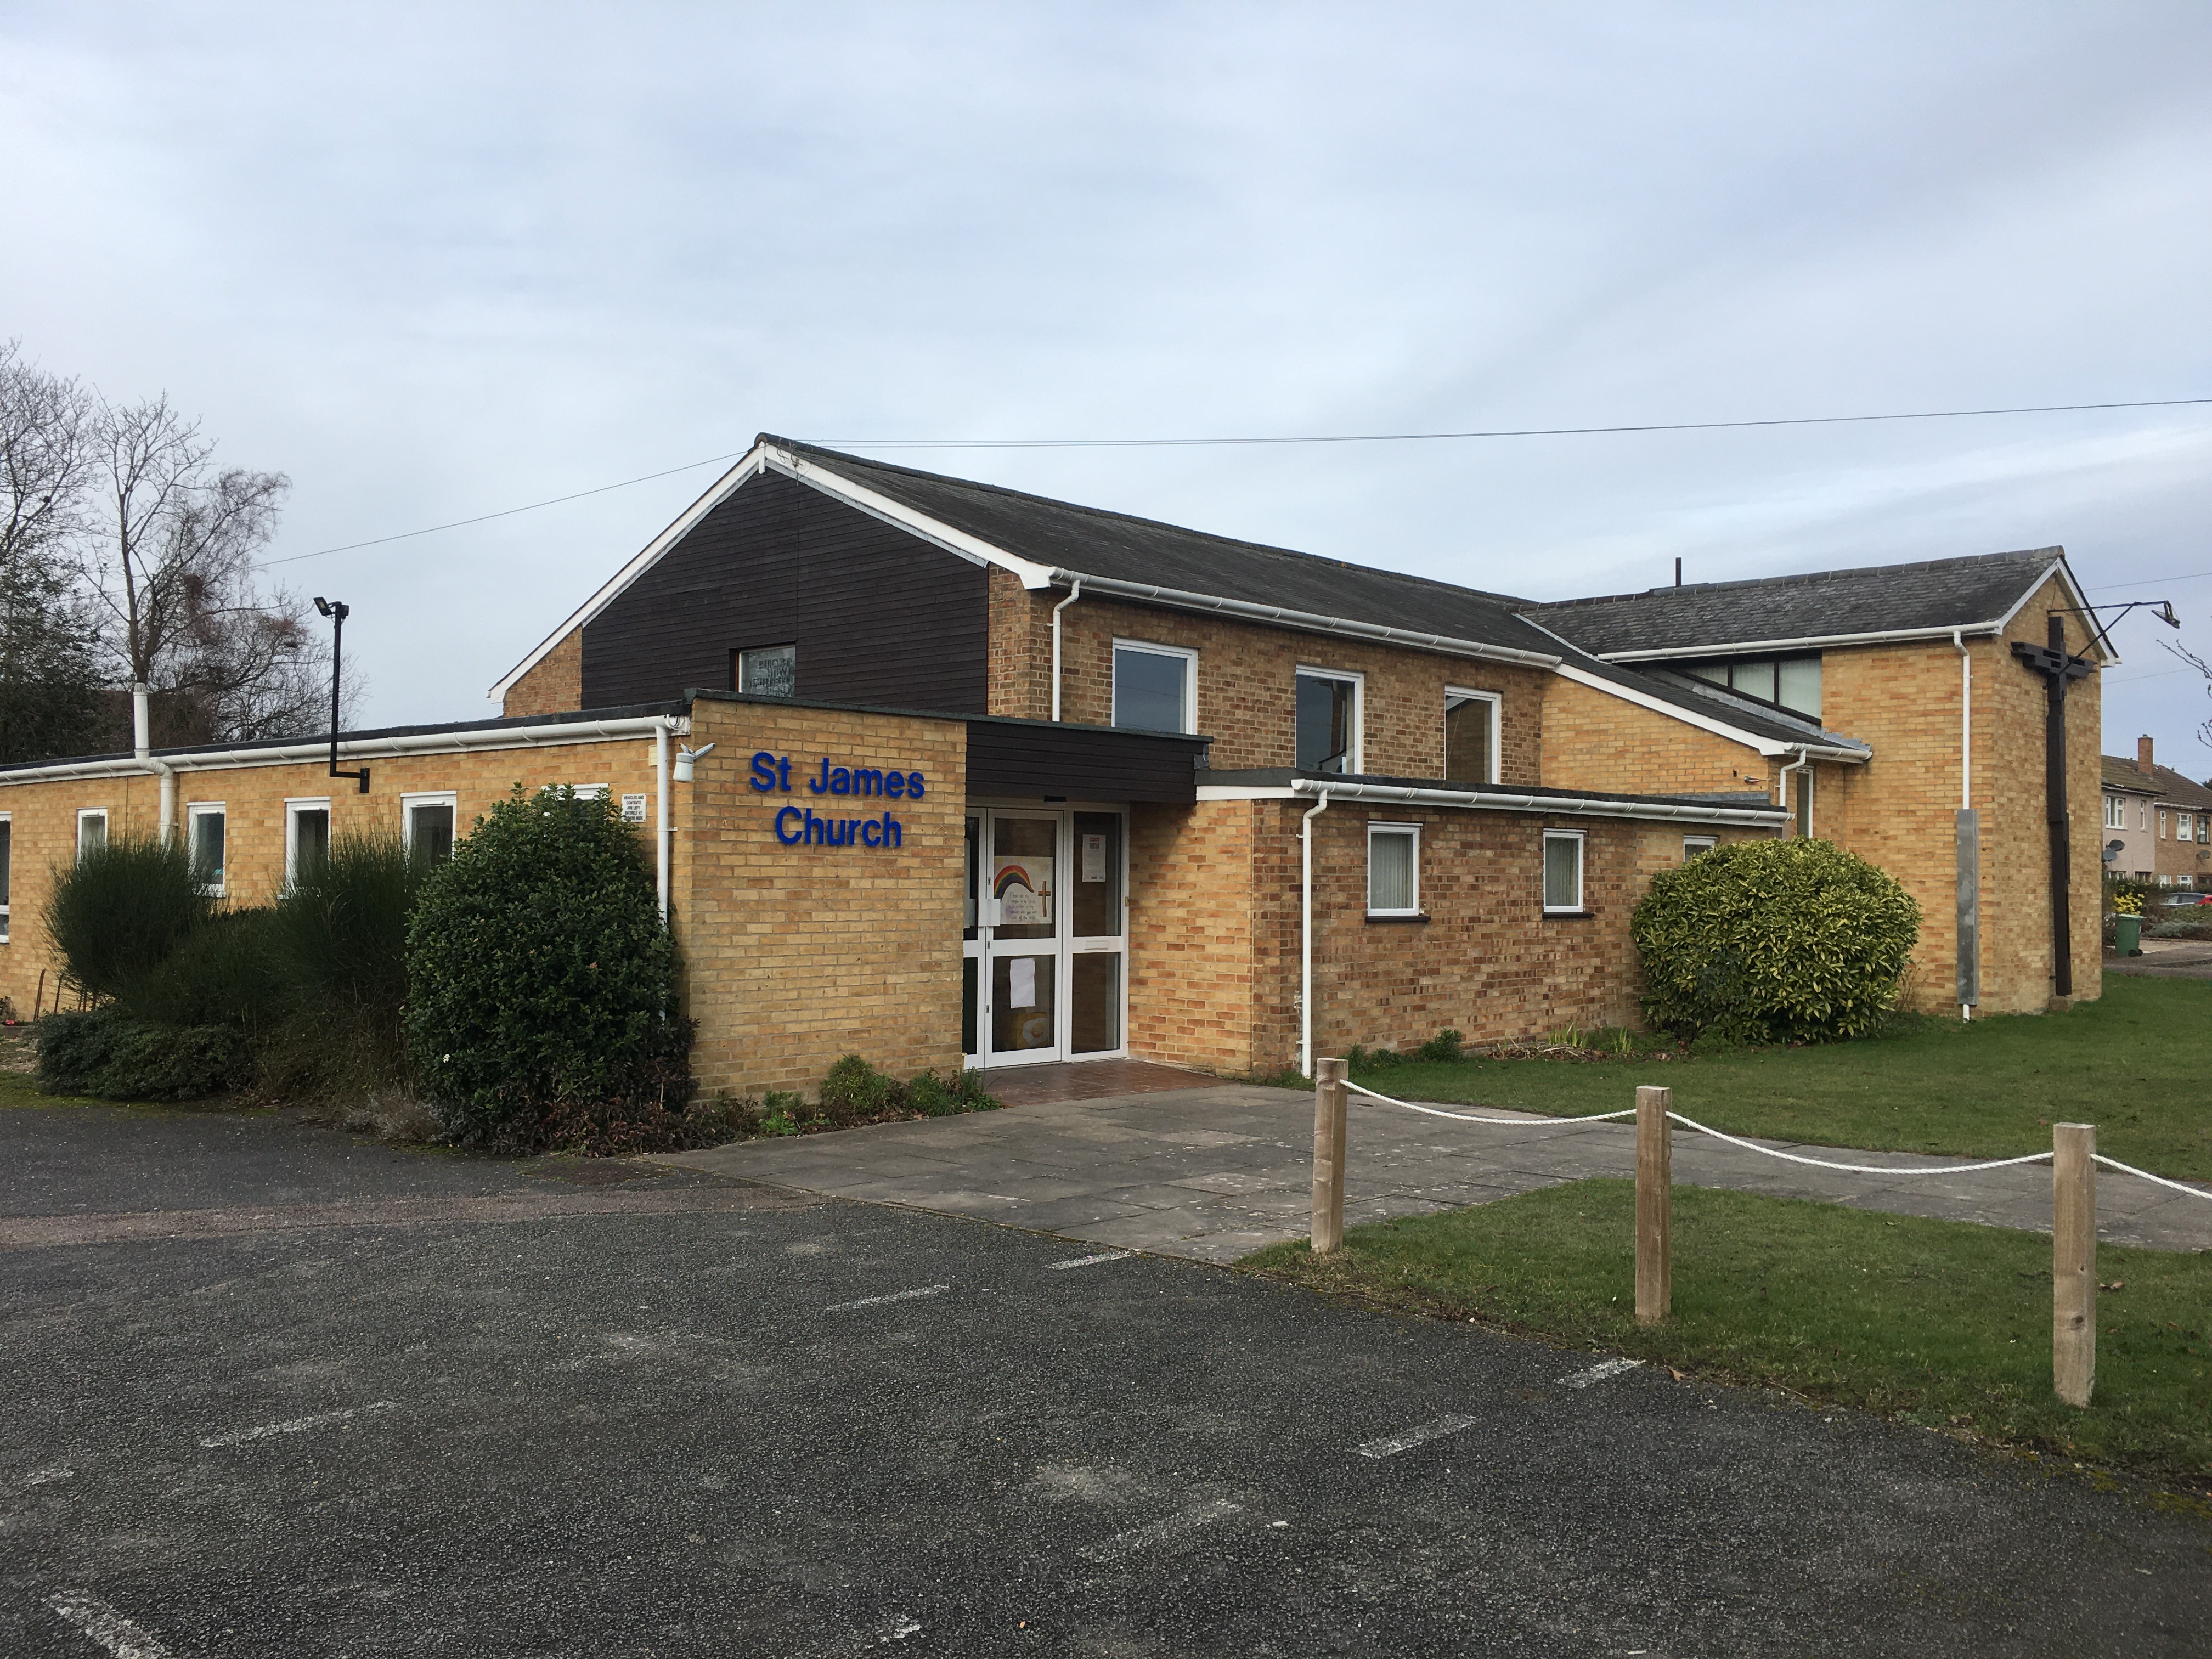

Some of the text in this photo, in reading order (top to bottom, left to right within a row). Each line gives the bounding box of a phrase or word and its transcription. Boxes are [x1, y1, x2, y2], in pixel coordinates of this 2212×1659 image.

[750, 752, 925, 799] St James
[775, 806, 902, 847] Church
